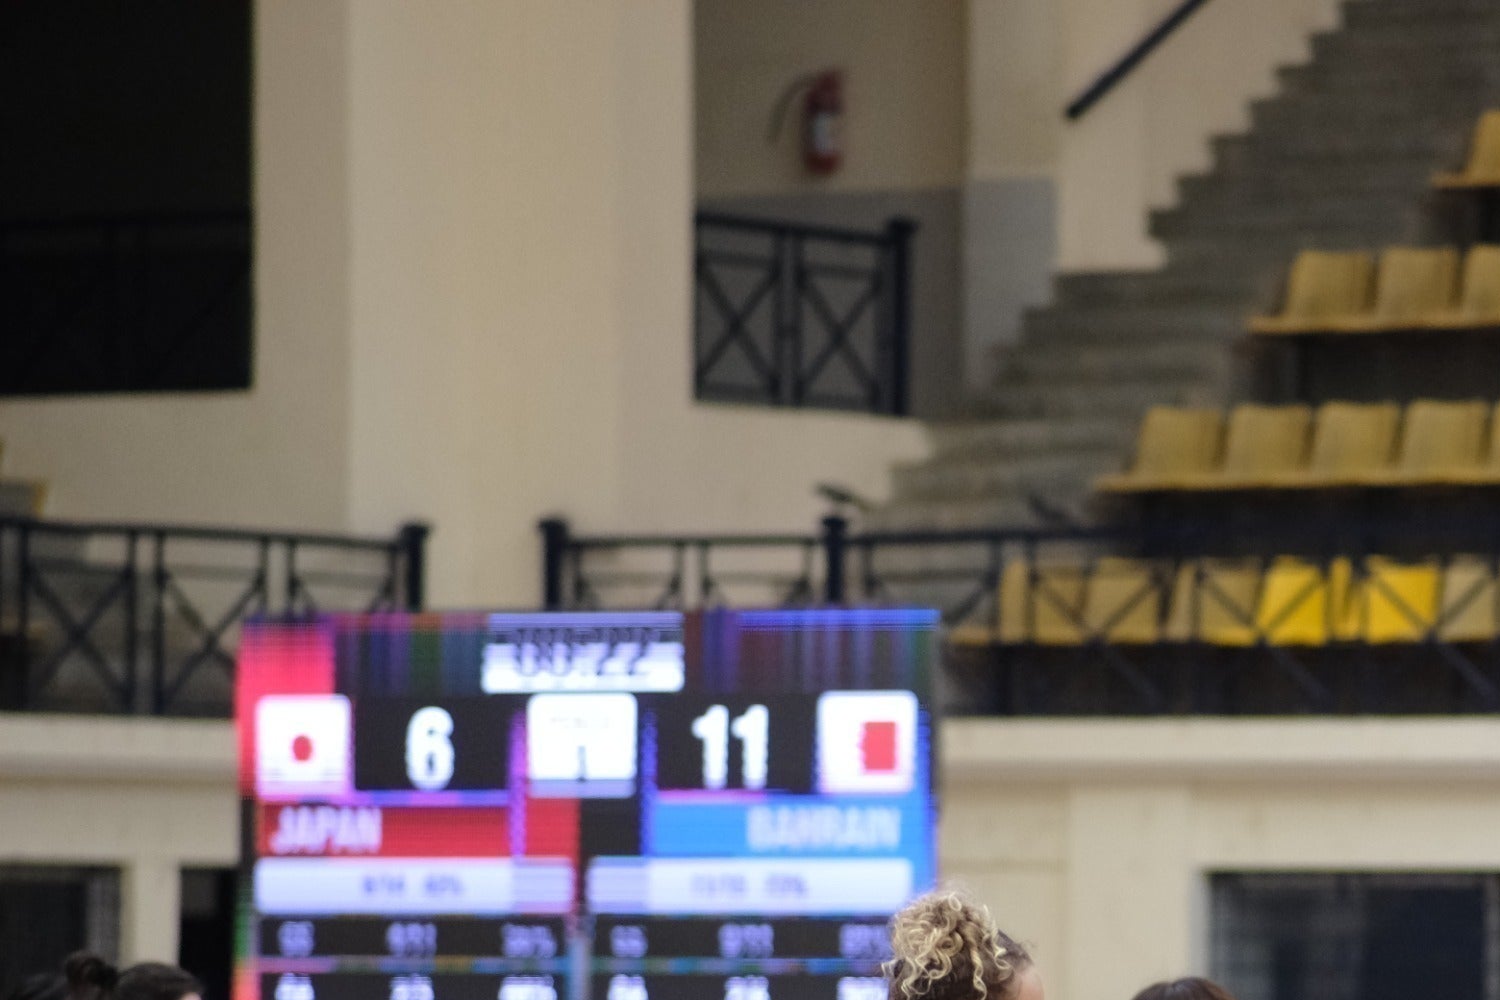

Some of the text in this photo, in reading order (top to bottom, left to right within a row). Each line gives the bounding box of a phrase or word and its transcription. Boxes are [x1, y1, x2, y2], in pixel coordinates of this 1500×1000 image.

[405, 706, 454, 790] 6
[691, 704, 769, 790] 11
[270, 805, 383, 854] JAPAN
[746, 806, 900, 850] BAHRAIN
